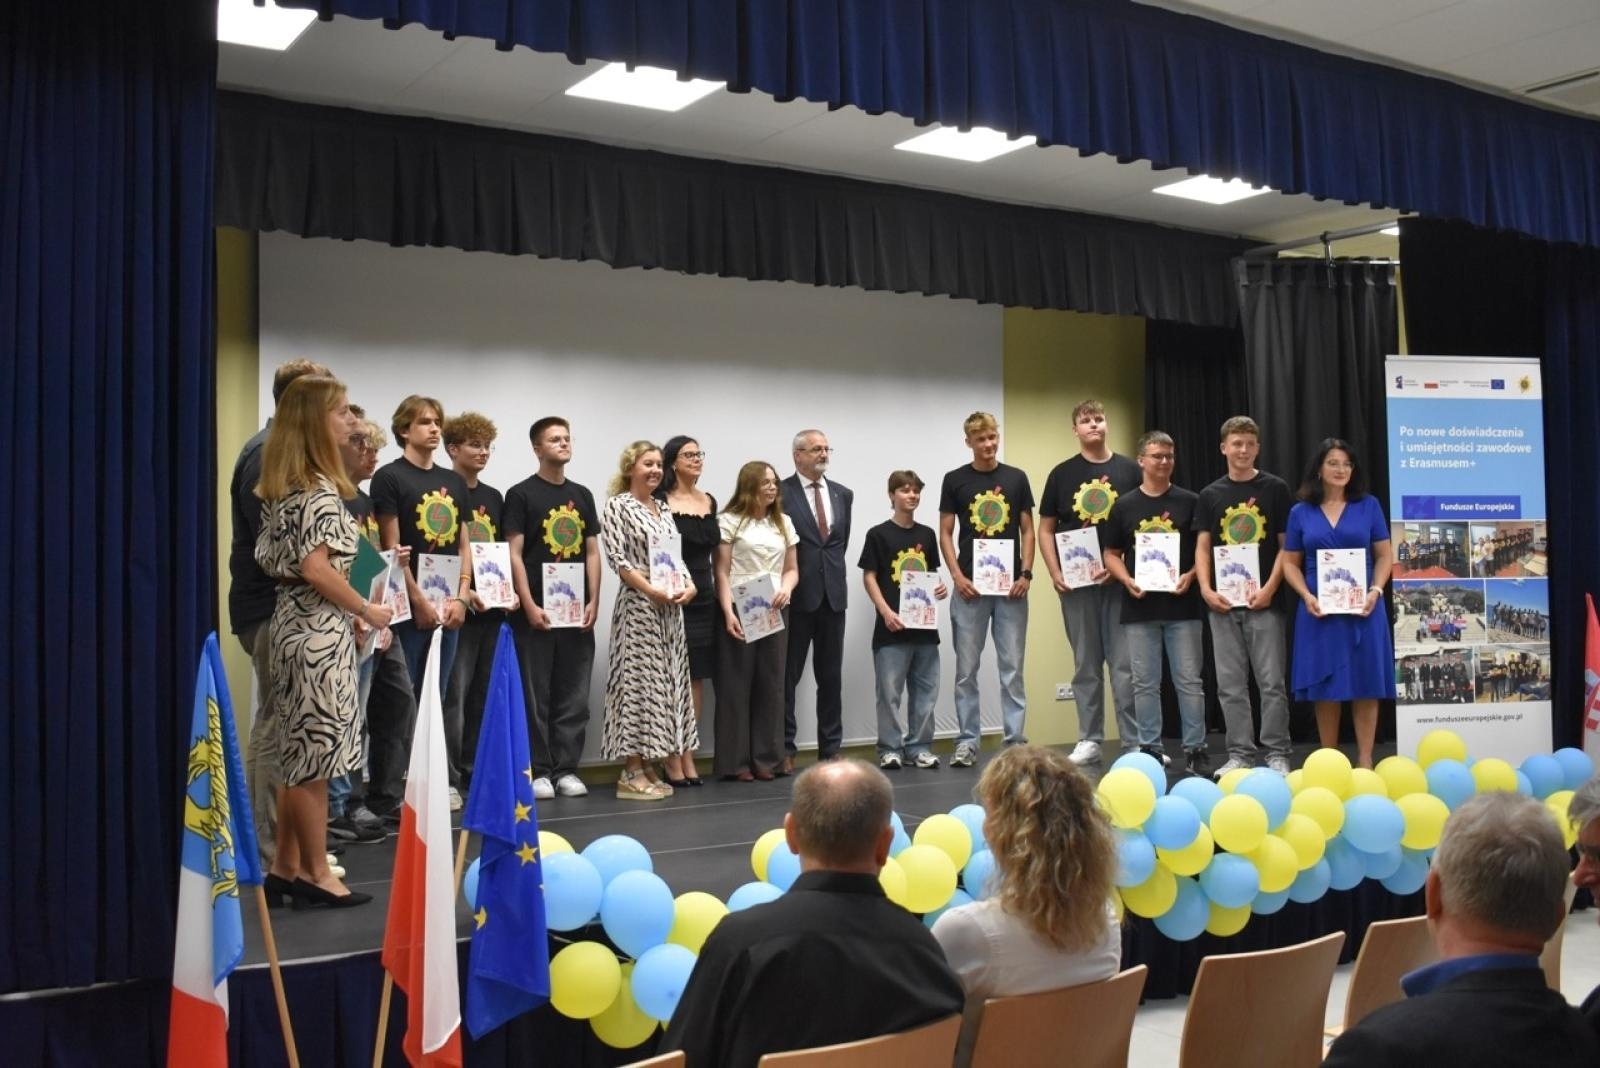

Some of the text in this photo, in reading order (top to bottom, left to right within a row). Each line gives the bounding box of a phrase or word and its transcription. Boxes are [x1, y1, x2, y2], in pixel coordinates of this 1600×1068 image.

[1400, 426, 1524, 438] Po nowe doświadczenia
[1406, 441, 1474, 455] umiejętności
[1476, 442, 1532, 454] zawodowe
[1401, 457, 1476, 469] z Erasmusem+
[1440, 503, 1515, 513] Fundusze Europejskie
[1416, 713, 1524, 724] www.funduszeeuropejskie.gov.pl
